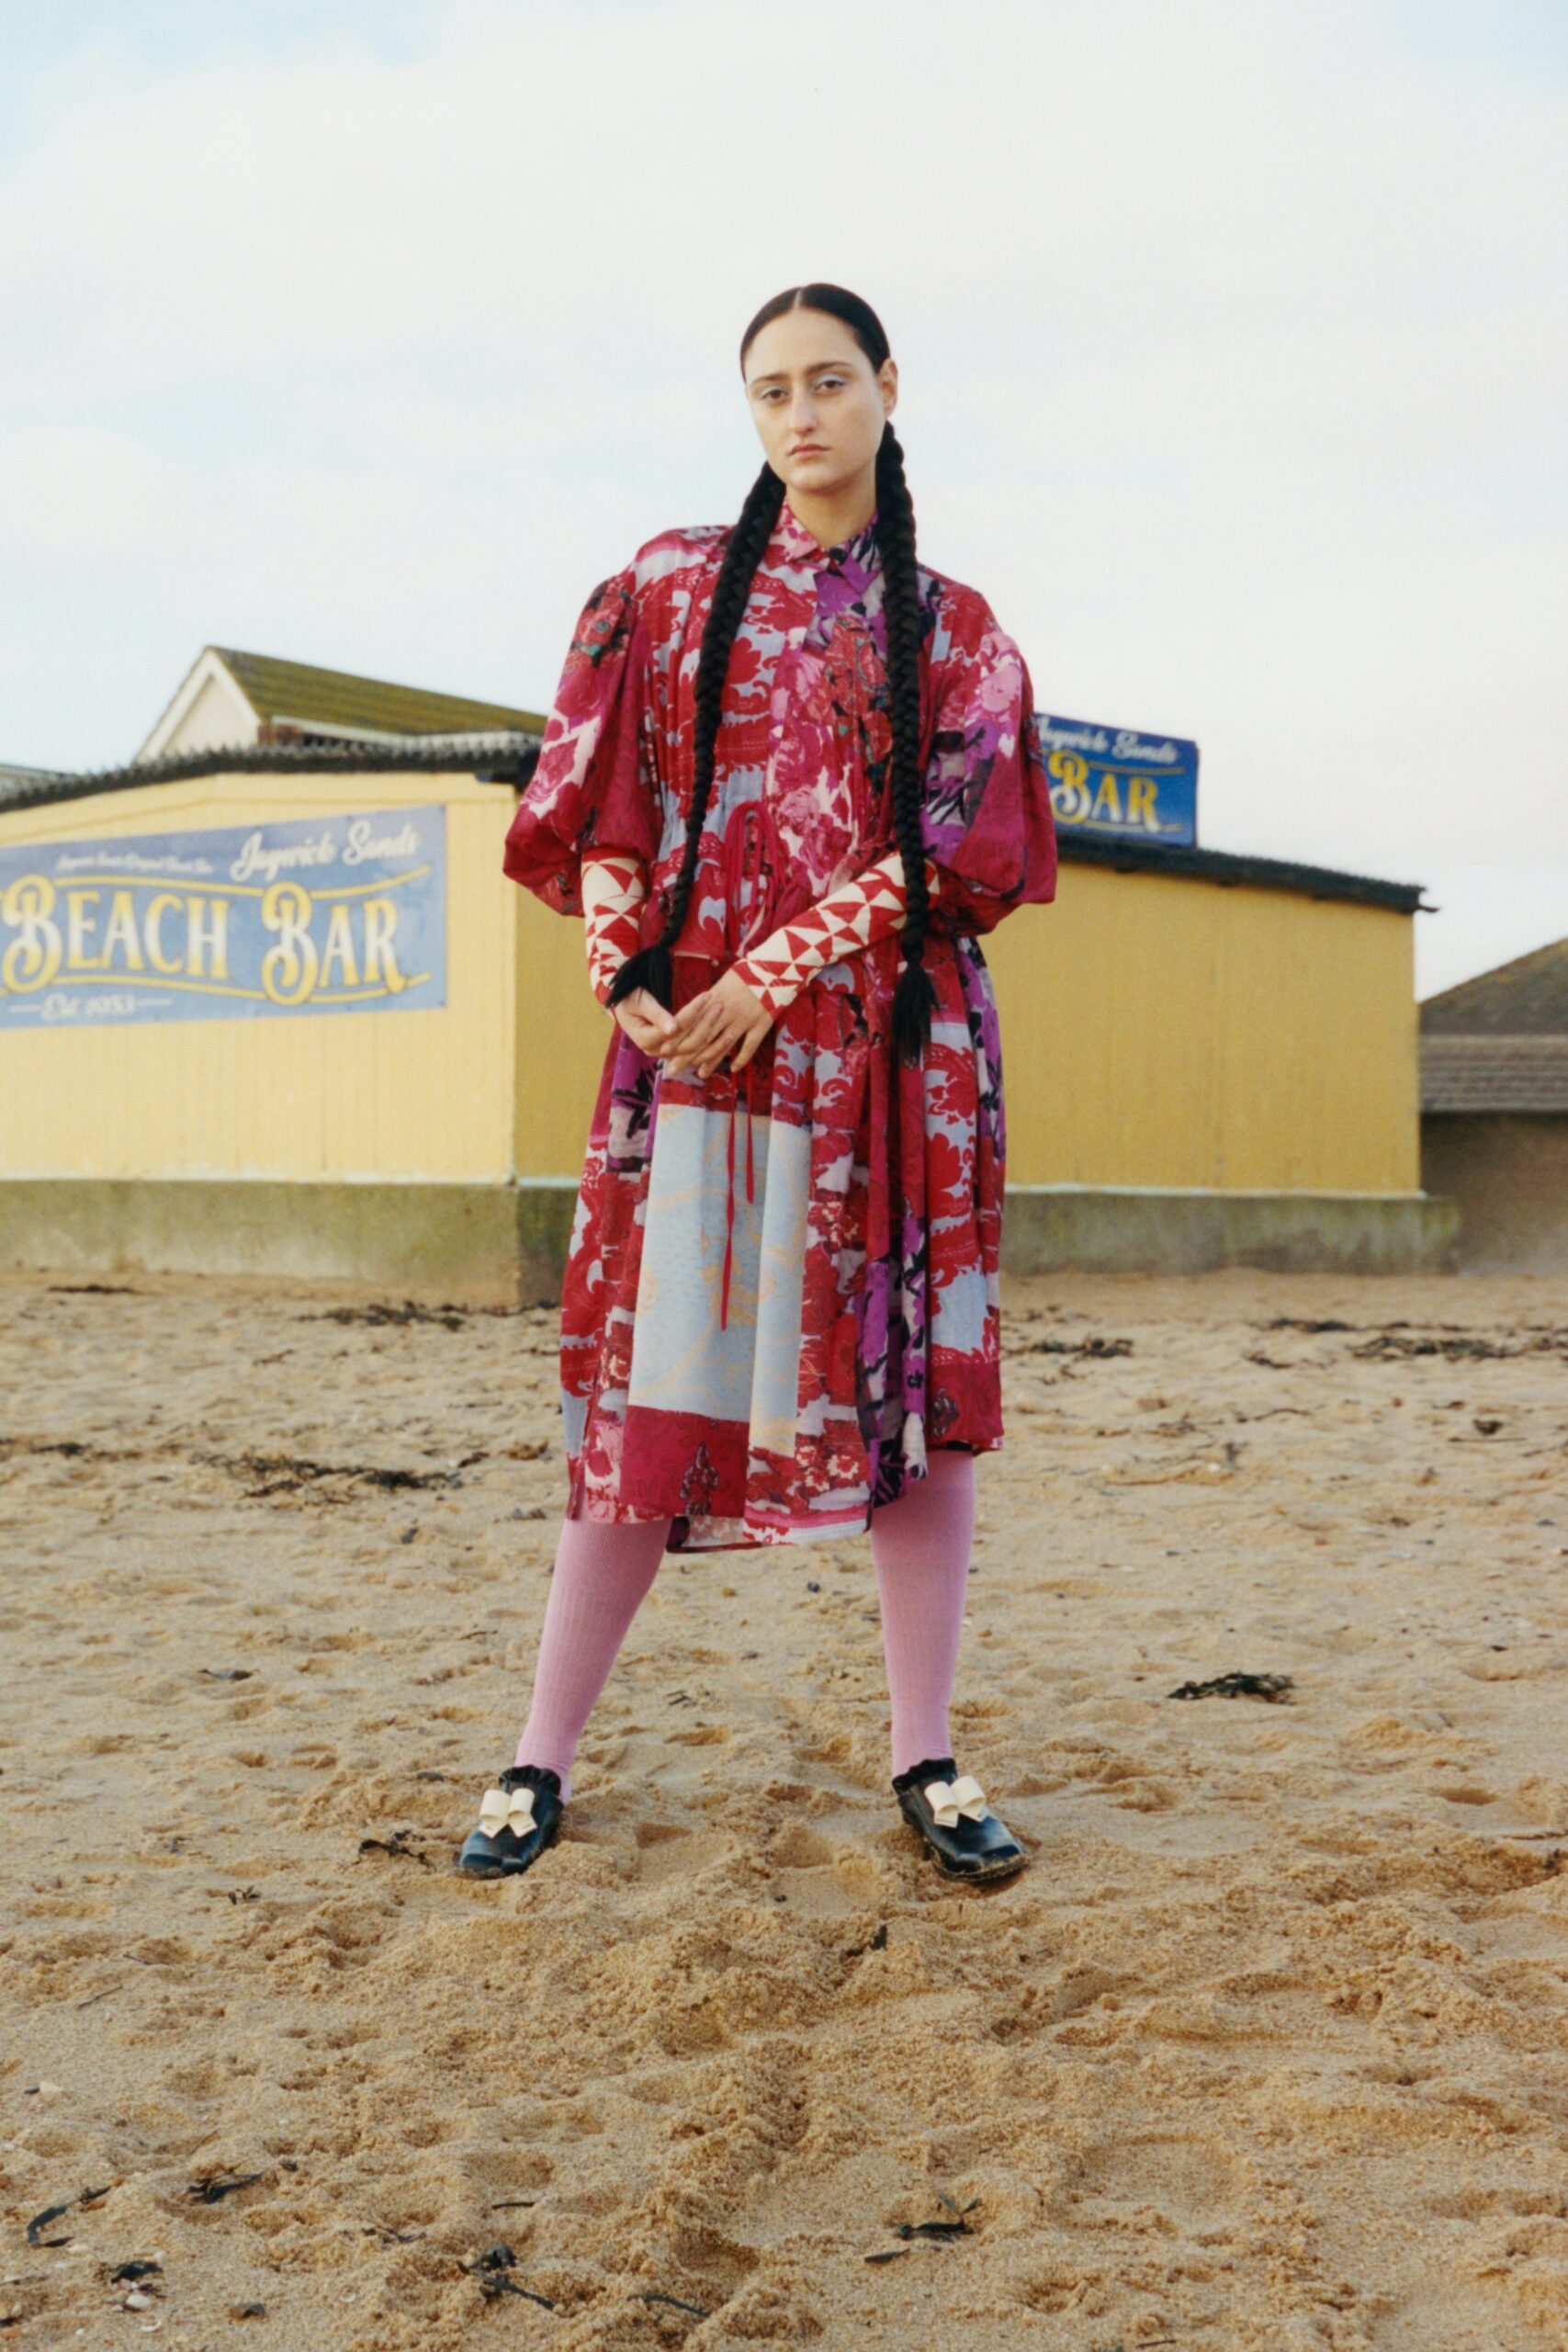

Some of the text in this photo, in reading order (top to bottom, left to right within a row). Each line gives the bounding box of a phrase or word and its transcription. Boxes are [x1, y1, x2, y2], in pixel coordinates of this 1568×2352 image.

[1048, 751, 1161, 832] BAR
[2, 875, 407, 1006] BEACH BAR
